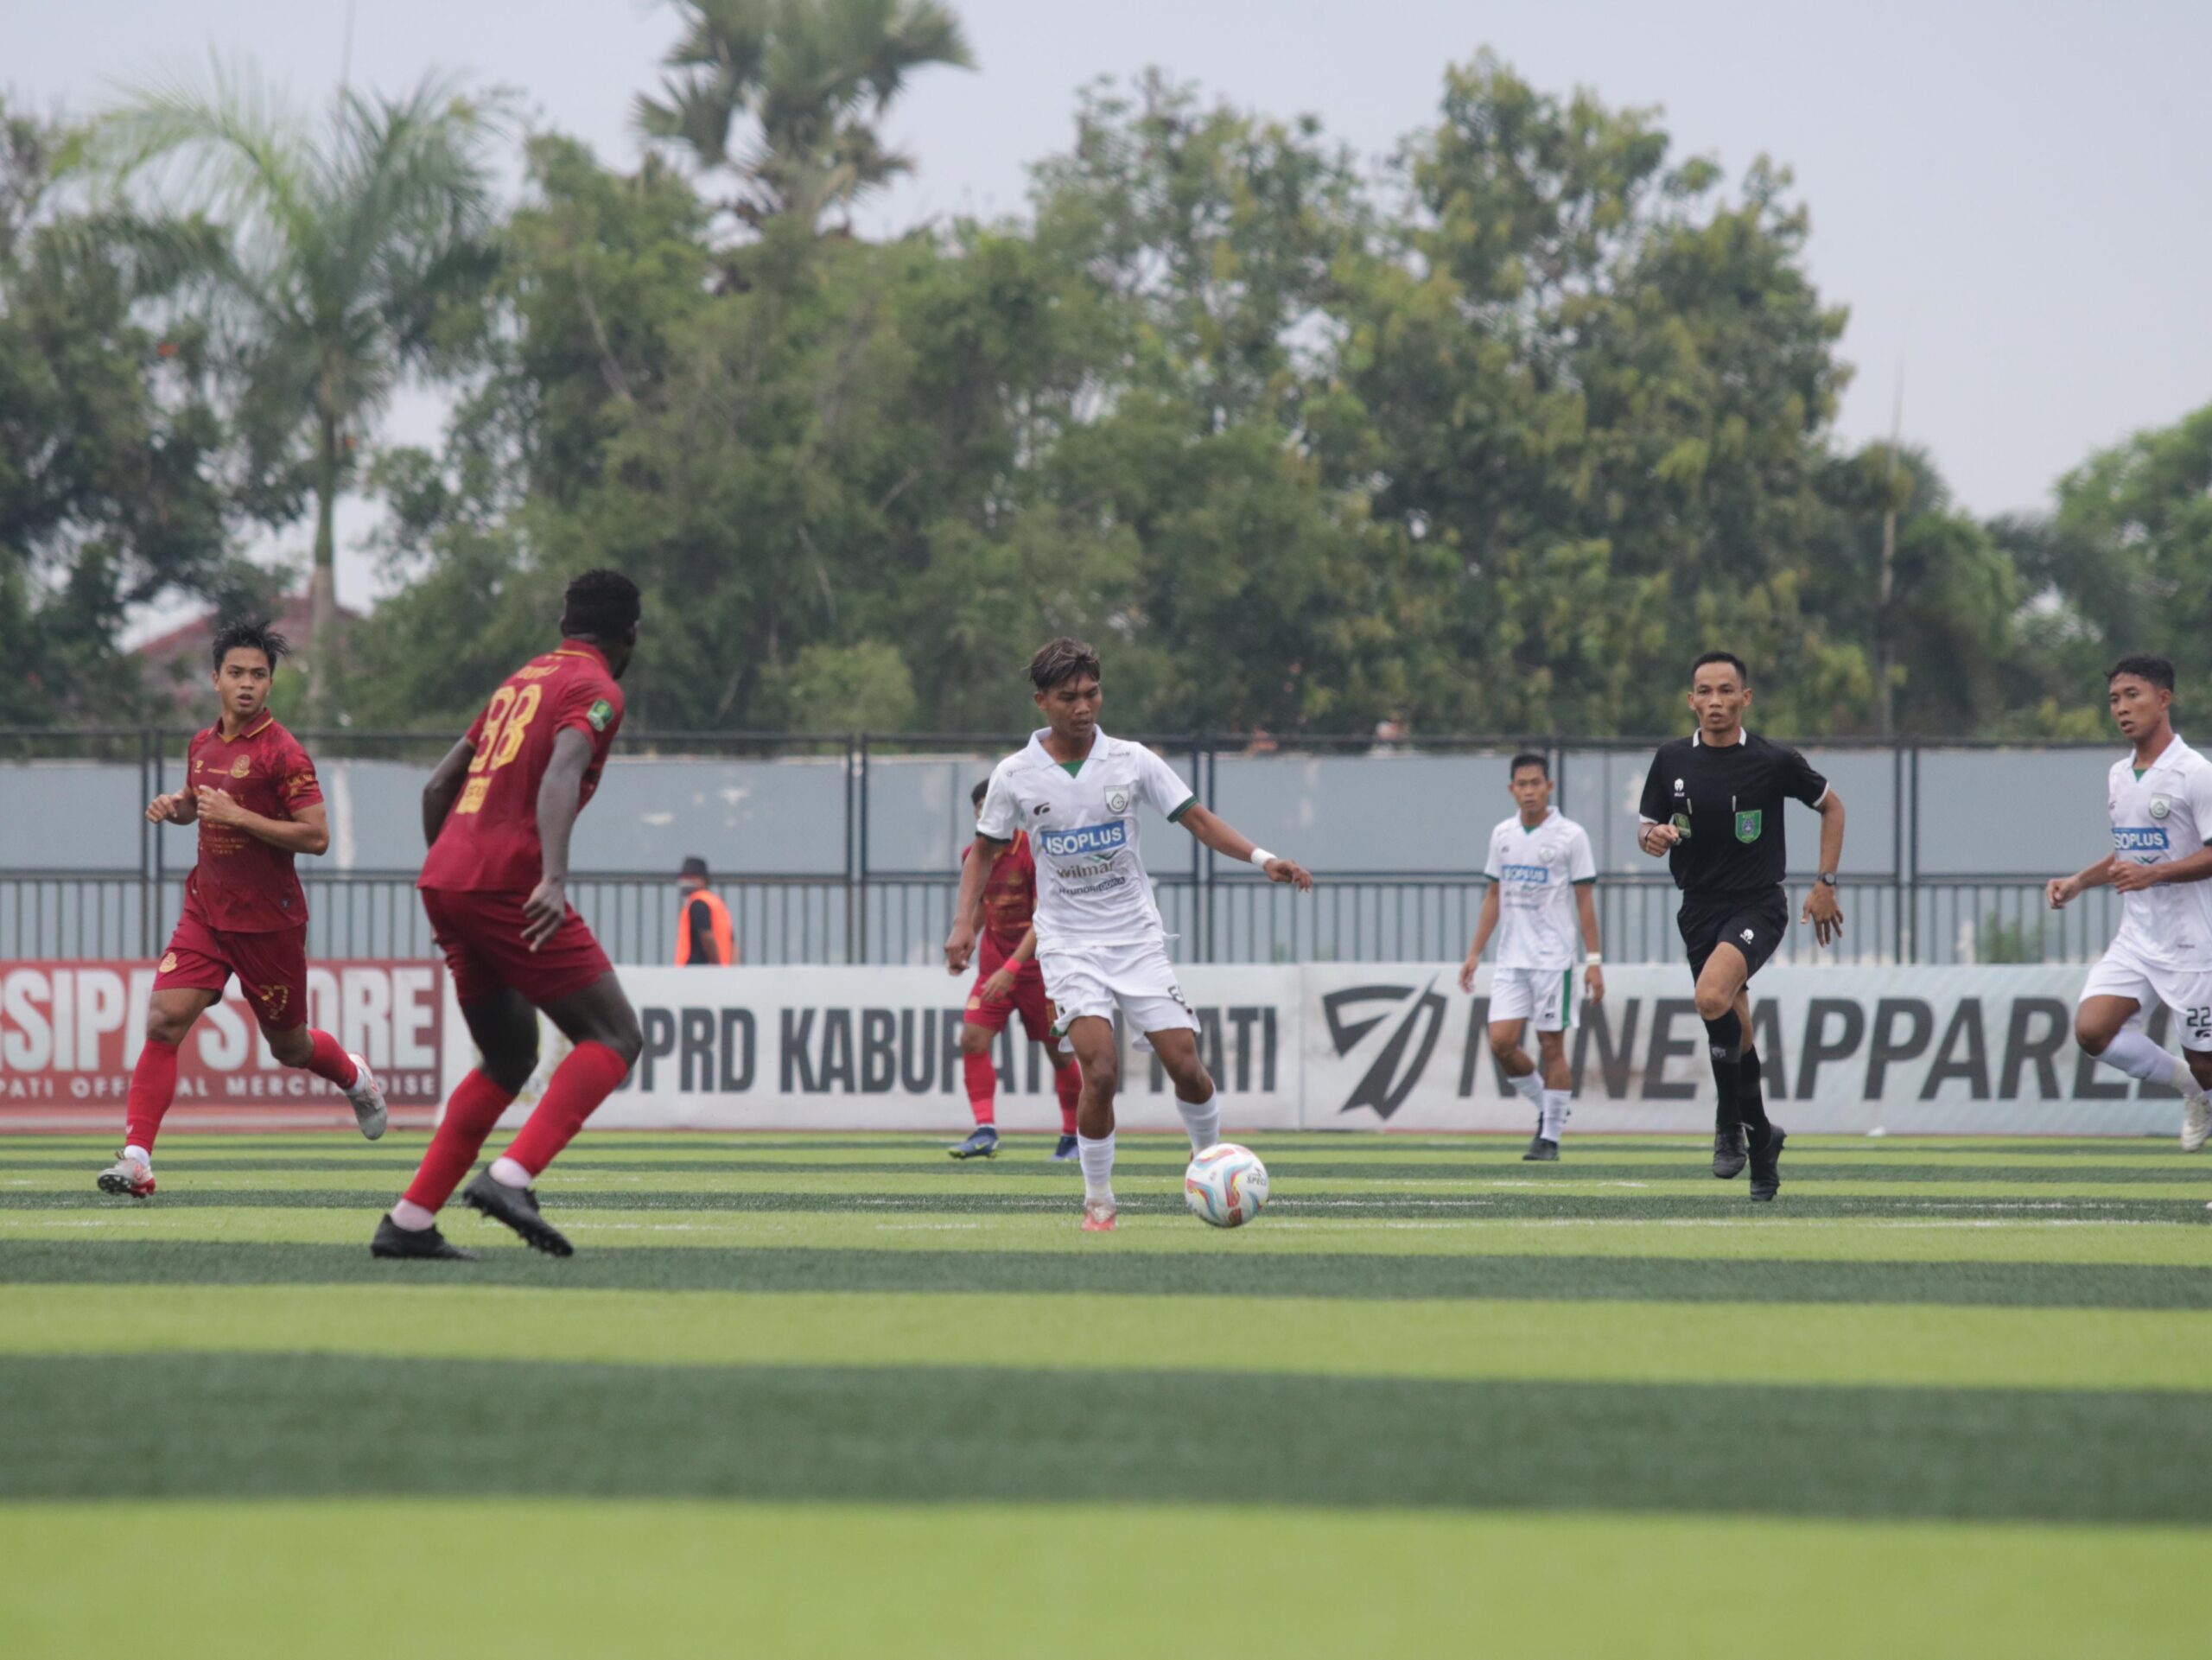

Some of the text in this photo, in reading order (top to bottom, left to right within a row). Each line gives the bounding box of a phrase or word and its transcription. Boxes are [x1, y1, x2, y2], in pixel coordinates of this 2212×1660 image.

[1046, 827, 1122, 855] ISOPLUS
[2186, 1006, 2212, 1027] 22
[615, 1007, 757, 1092] PRD
[1150, 1007, 1276, 1093] ATI
[1458, 996, 1703, 1099] NNE
[70, 1076, 208, 1098] OFFAL
